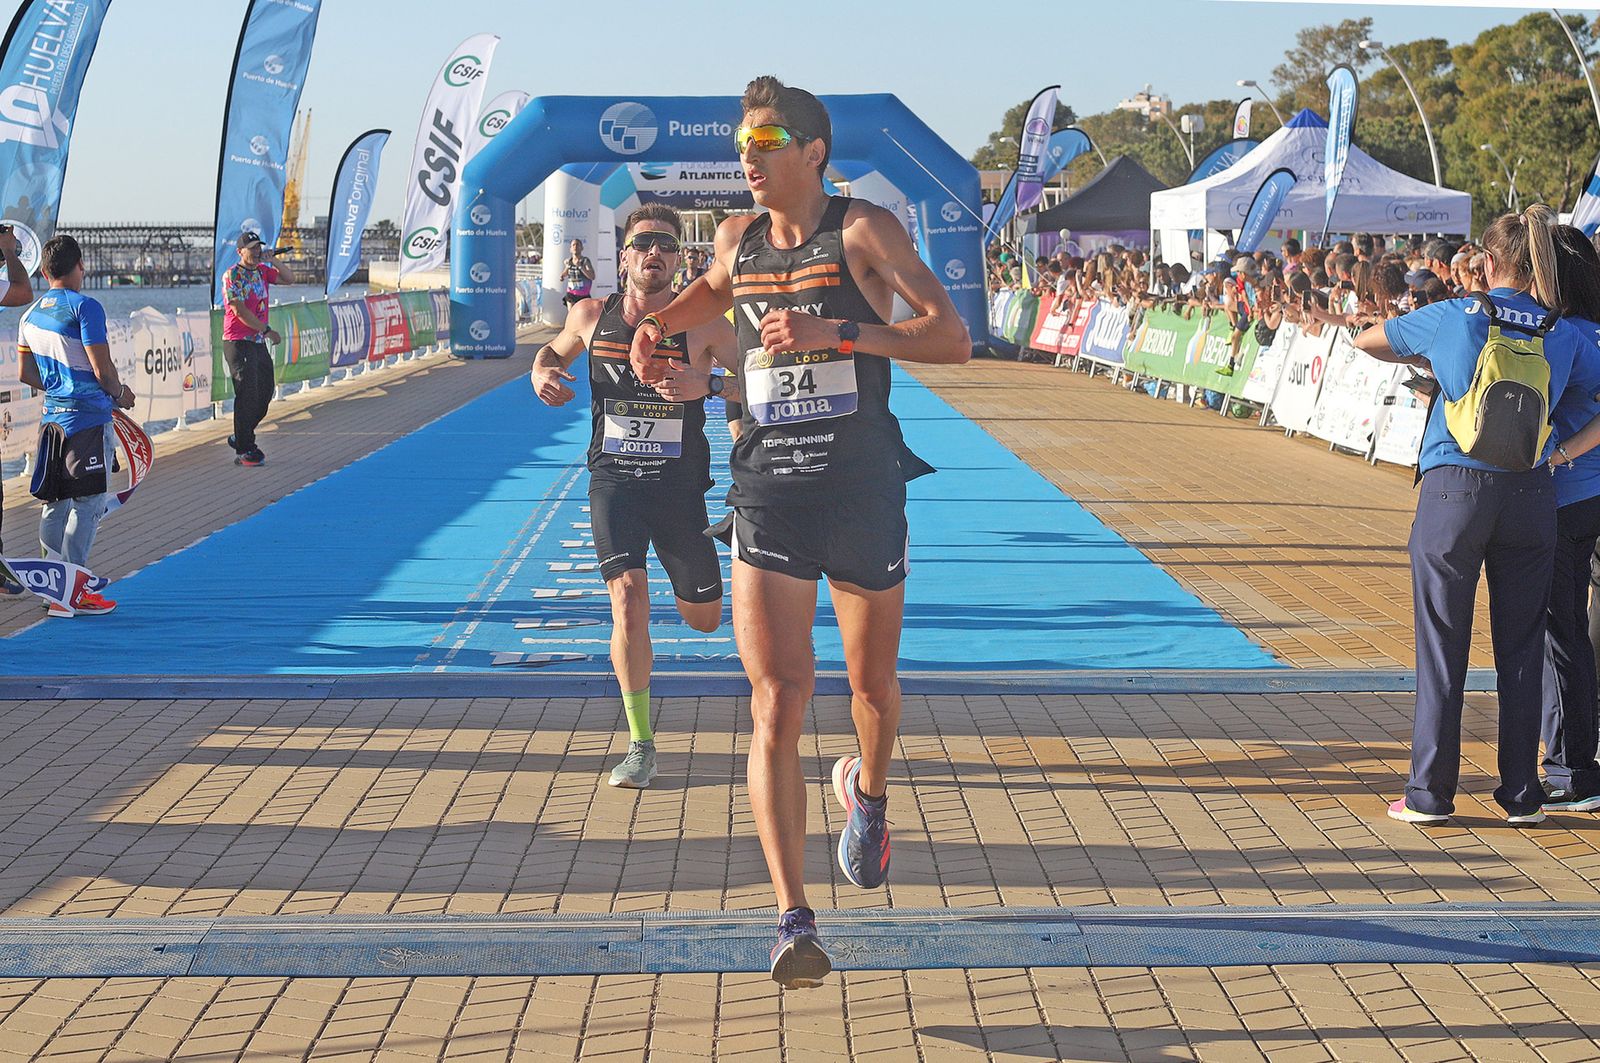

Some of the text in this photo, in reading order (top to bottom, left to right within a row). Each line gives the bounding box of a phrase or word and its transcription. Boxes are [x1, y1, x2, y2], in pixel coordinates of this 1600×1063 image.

[19, 0, 75, 92] HUELVA
[453, 63, 484, 81] CSIF
[242, 71, 298, 91] Puerto de Huelva
[486, 117, 508, 130] CSI
[669, 120, 732, 137] Puerto
[230, 154, 252, 165] Puerto
[252, 158, 261, 166] de
[418, 109, 463, 207] CSIF
[350, 148, 371, 200] original
[679, 170, 733, 181] ATLANTIC
[694, 198, 730, 209] Syrluz
[551, 207, 589, 219] Huelva
[455, 228, 475, 237] Puerto
[485, 229, 508, 237] Huelva
[957, 224, 978, 232] Huelva
[411, 235, 442, 251] CSIF
[485, 287, 507, 295] Huelva
[962, 282, 983, 290] Huelva
[454, 343, 507, 352] Puerto de Huelva
[144, 338, 182, 382] cajas
[795, 353, 829, 364] LOOP
[779, 368, 817, 397] 34
[633, 403, 674, 411] RUNNING
[769, 398, 832, 421] Joma
[629, 420, 655, 439] 37
[620, 441, 663, 453] Joma
[489, 651, 589, 666] 10
